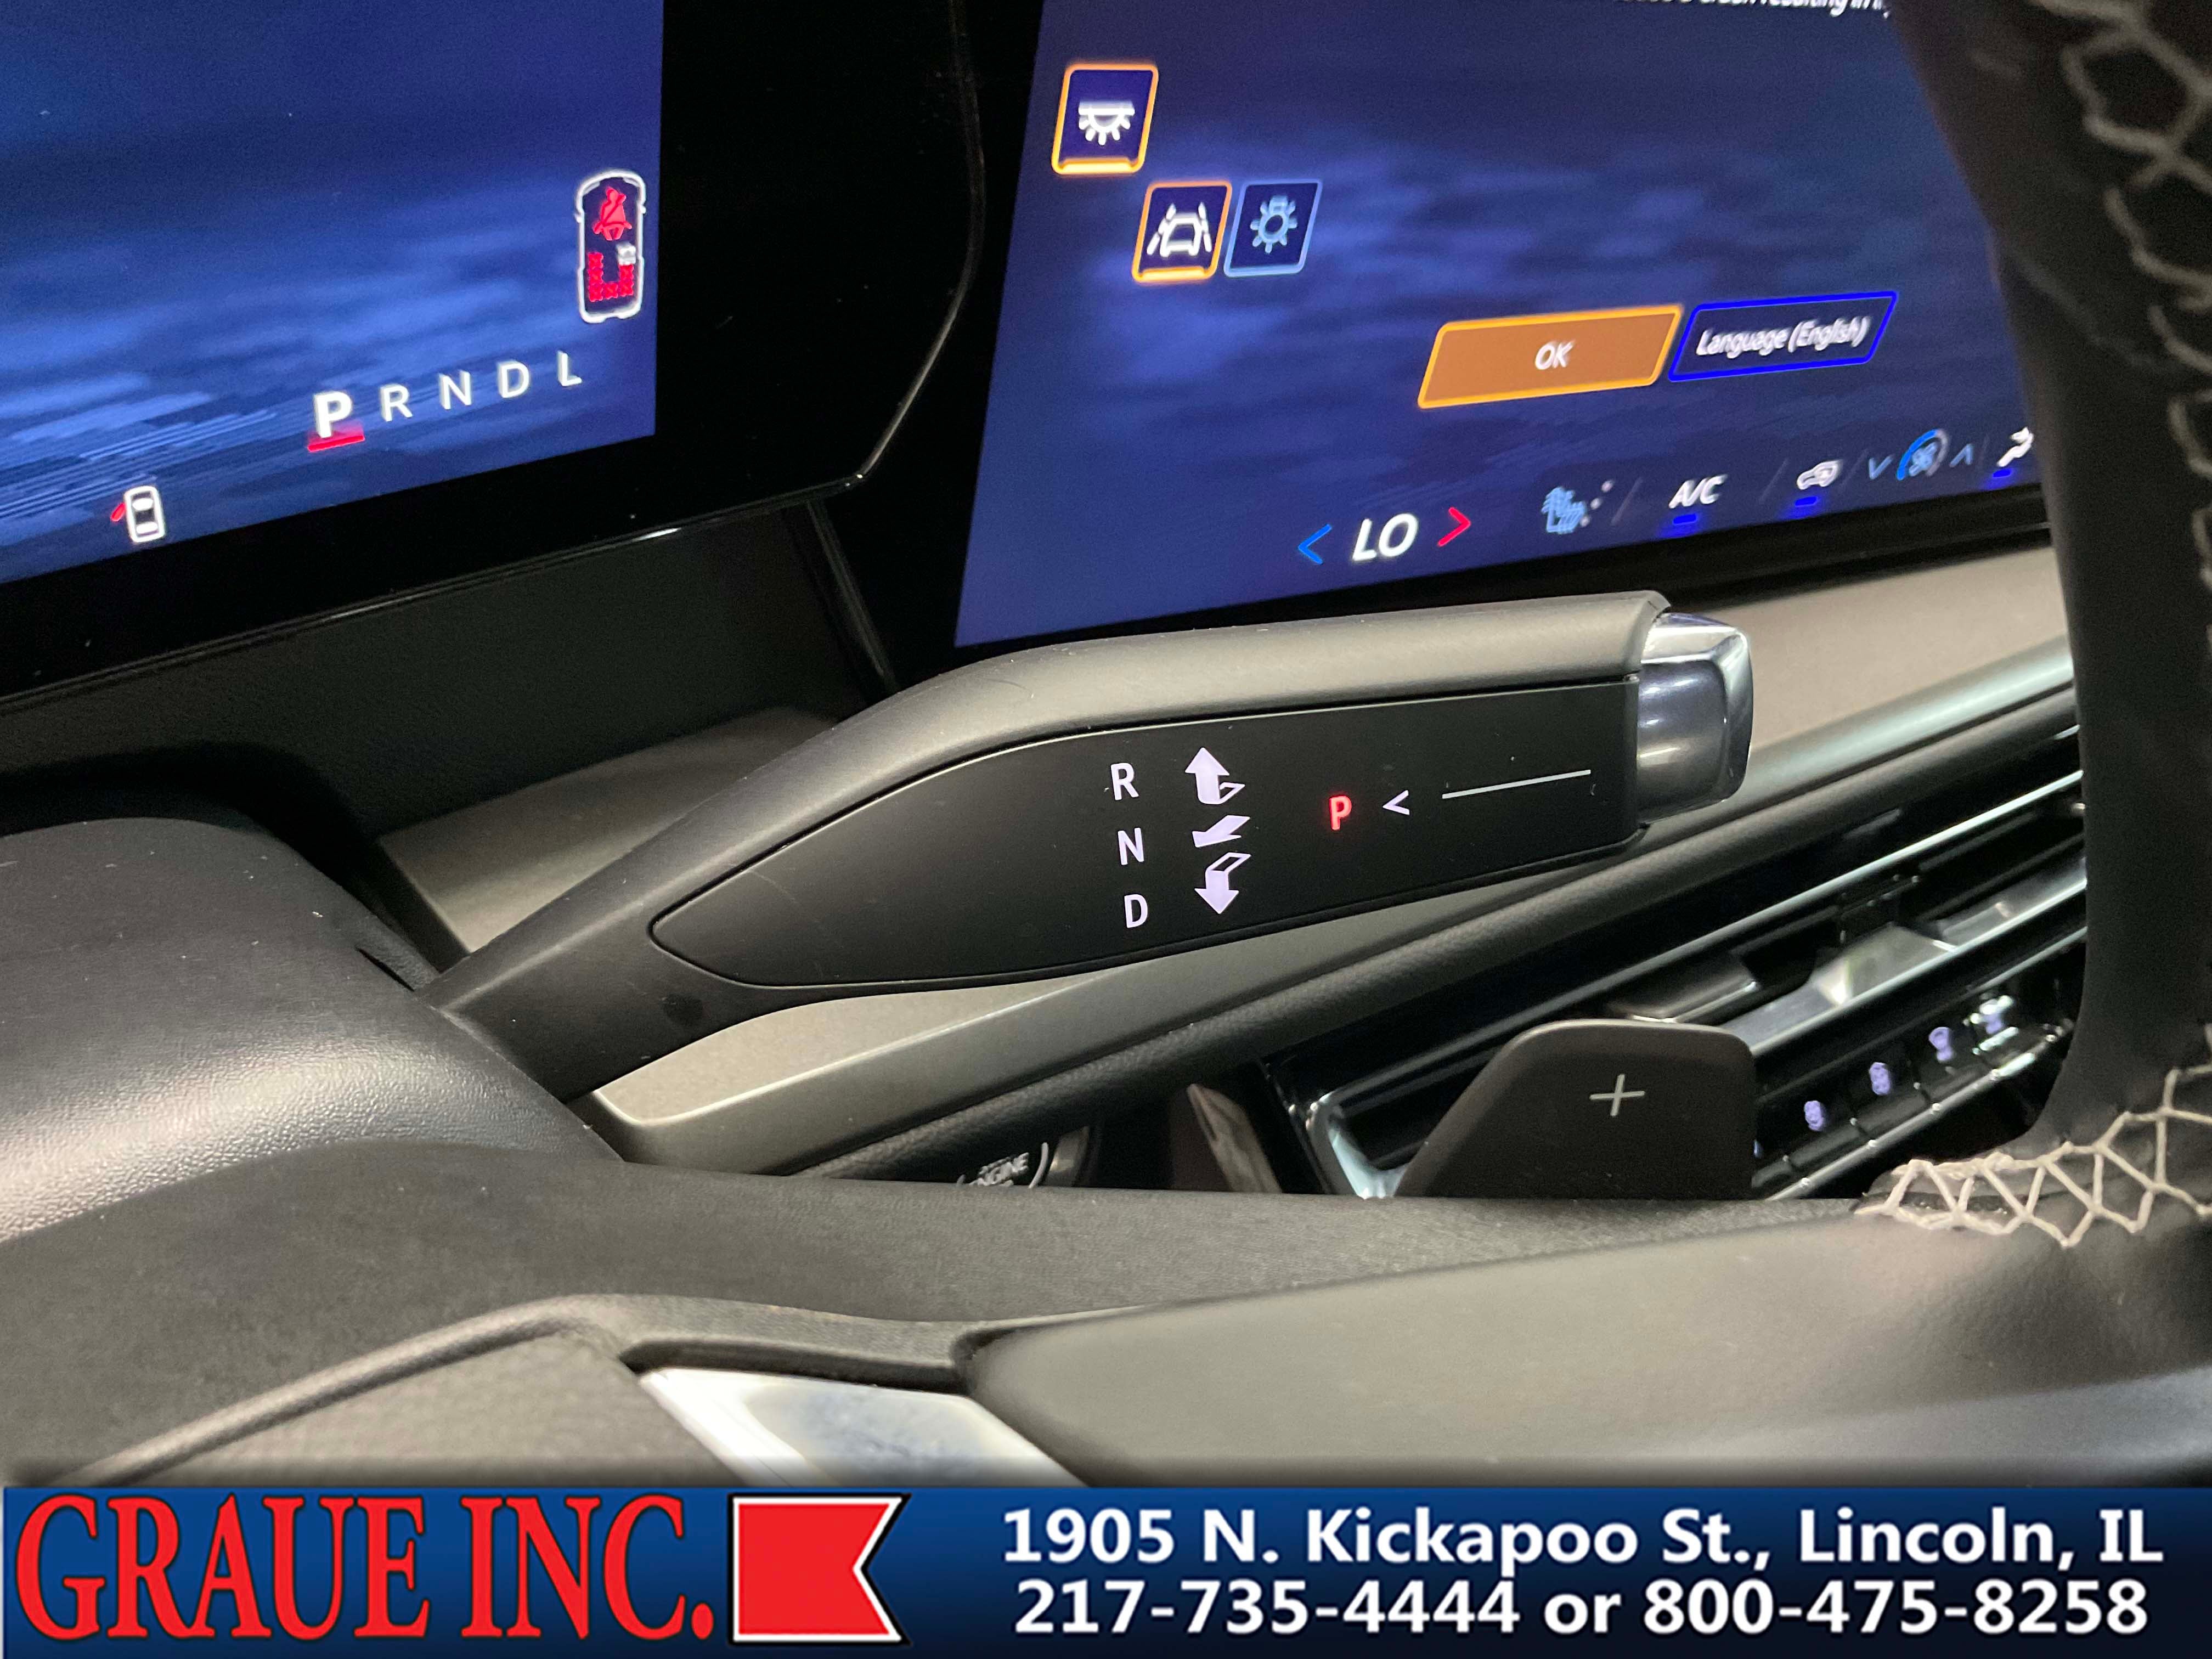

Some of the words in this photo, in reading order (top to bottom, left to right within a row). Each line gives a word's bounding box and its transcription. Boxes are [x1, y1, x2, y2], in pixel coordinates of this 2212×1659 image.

[1534, 341, 1573, 370] OK
[1696, 328, 1791, 359] Language
[1787, 316, 1871, 353] (English)
[313, 392, 353, 438] P
[381, 384, 412, 421] R
[440, 370, 472, 409] N
[498, 360, 530, 398] D
[557, 351, 582, 386] L
[1669, 475, 1727, 508] A/C
[1353, 513, 1419, 562] LO
[1111, 763, 1138, 800] R
[1329, 795, 1352, 831] P
[1118, 827, 1144, 865] N
[1124, 894, 1148, 929] D
